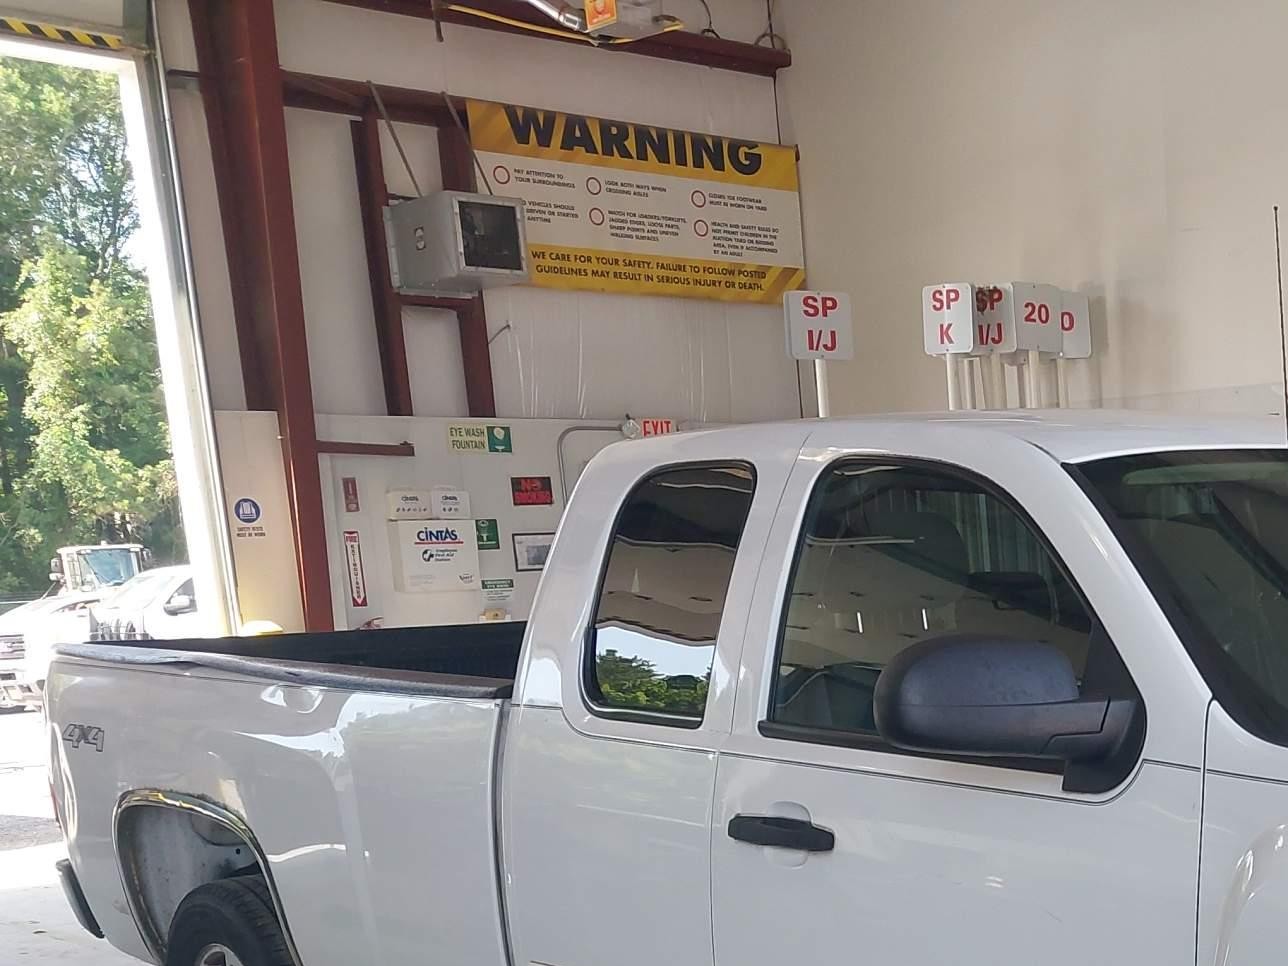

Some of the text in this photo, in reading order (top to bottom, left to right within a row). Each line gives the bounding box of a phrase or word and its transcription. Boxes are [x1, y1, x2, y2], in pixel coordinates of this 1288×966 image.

[502, 104, 762, 176] WARNING
[531, 251, 546, 260] WE
[549, 252, 570, 262] CARE
[575, 255, 592, 264] FOR
[596, 257, 619, 266] YOUR
[656, 262, 687, 272] FAILURE
[689, 265, 700, 274] TO
[703, 266, 735, 276] FOLLOW
[738, 269, 767, 279] POSTED
[536, 264, 588, 277] GUIDELINES
[592, 269, 610, 278] MAY
[613, 271, 641, 281] RESULT
[644, 274, 653, 282] IN
[657, 276, 691, 286] SERIOUS
[693, 278, 722, 288] INJURY
[725, 280, 736, 289] OR
[802, 295, 838, 318] SP
[932, 288, 960, 311] SP
[1024, 302, 1050, 324] 20
[806, 329, 837, 351] I/J
[939, 323, 955, 345] K
[450, 426, 485, 437] EYE WASH
[643, 420, 672, 437] EXIT
[452, 439, 486, 449] FOUNTAIN
